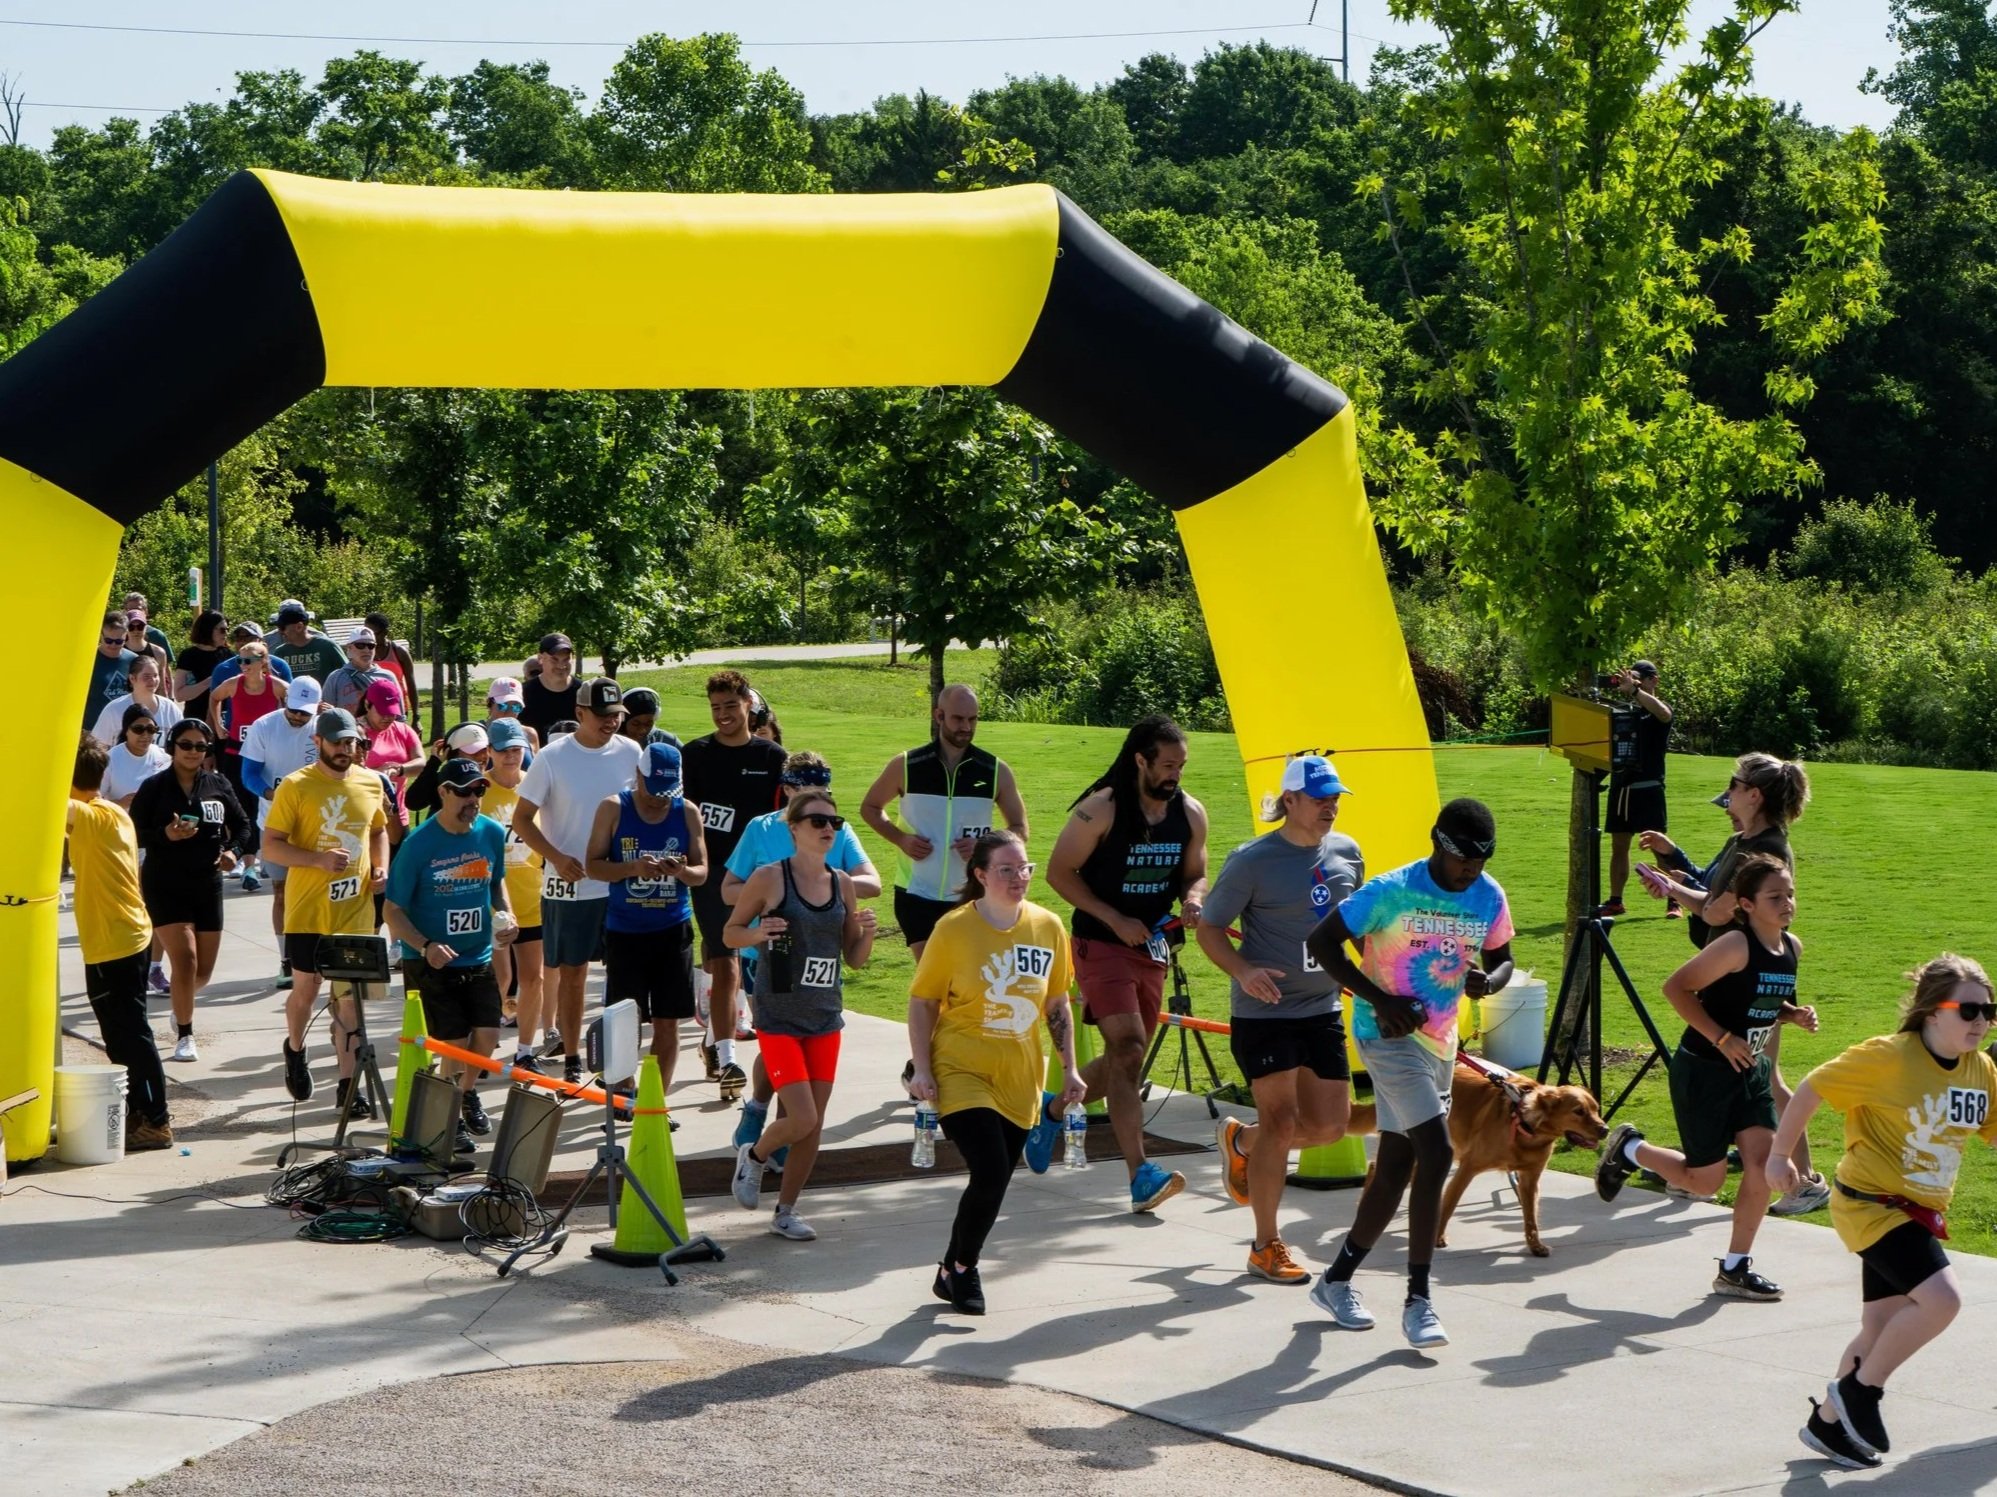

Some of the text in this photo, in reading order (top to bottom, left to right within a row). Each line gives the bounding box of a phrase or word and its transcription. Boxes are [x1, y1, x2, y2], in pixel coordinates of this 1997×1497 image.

[283, 652, 321, 665] BUCKS
[701, 805, 733, 829] 557
[1129, 843, 1182, 853] TENNESSEE
[330, 879, 358, 900] 571
[546, 878, 576, 898] 554
[449, 909, 480, 932] 520
[1416, 907, 1428, 915] The
[1402, 915, 1489, 938] TENNESSEE
[1410, 940, 1430, 949] EST.
[805, 960, 835, 985] 521
[1017, 947, 1053, 977] 567
[1750, 1029, 1773, 1052] 60
[1950, 1090, 1987, 1125] 568
